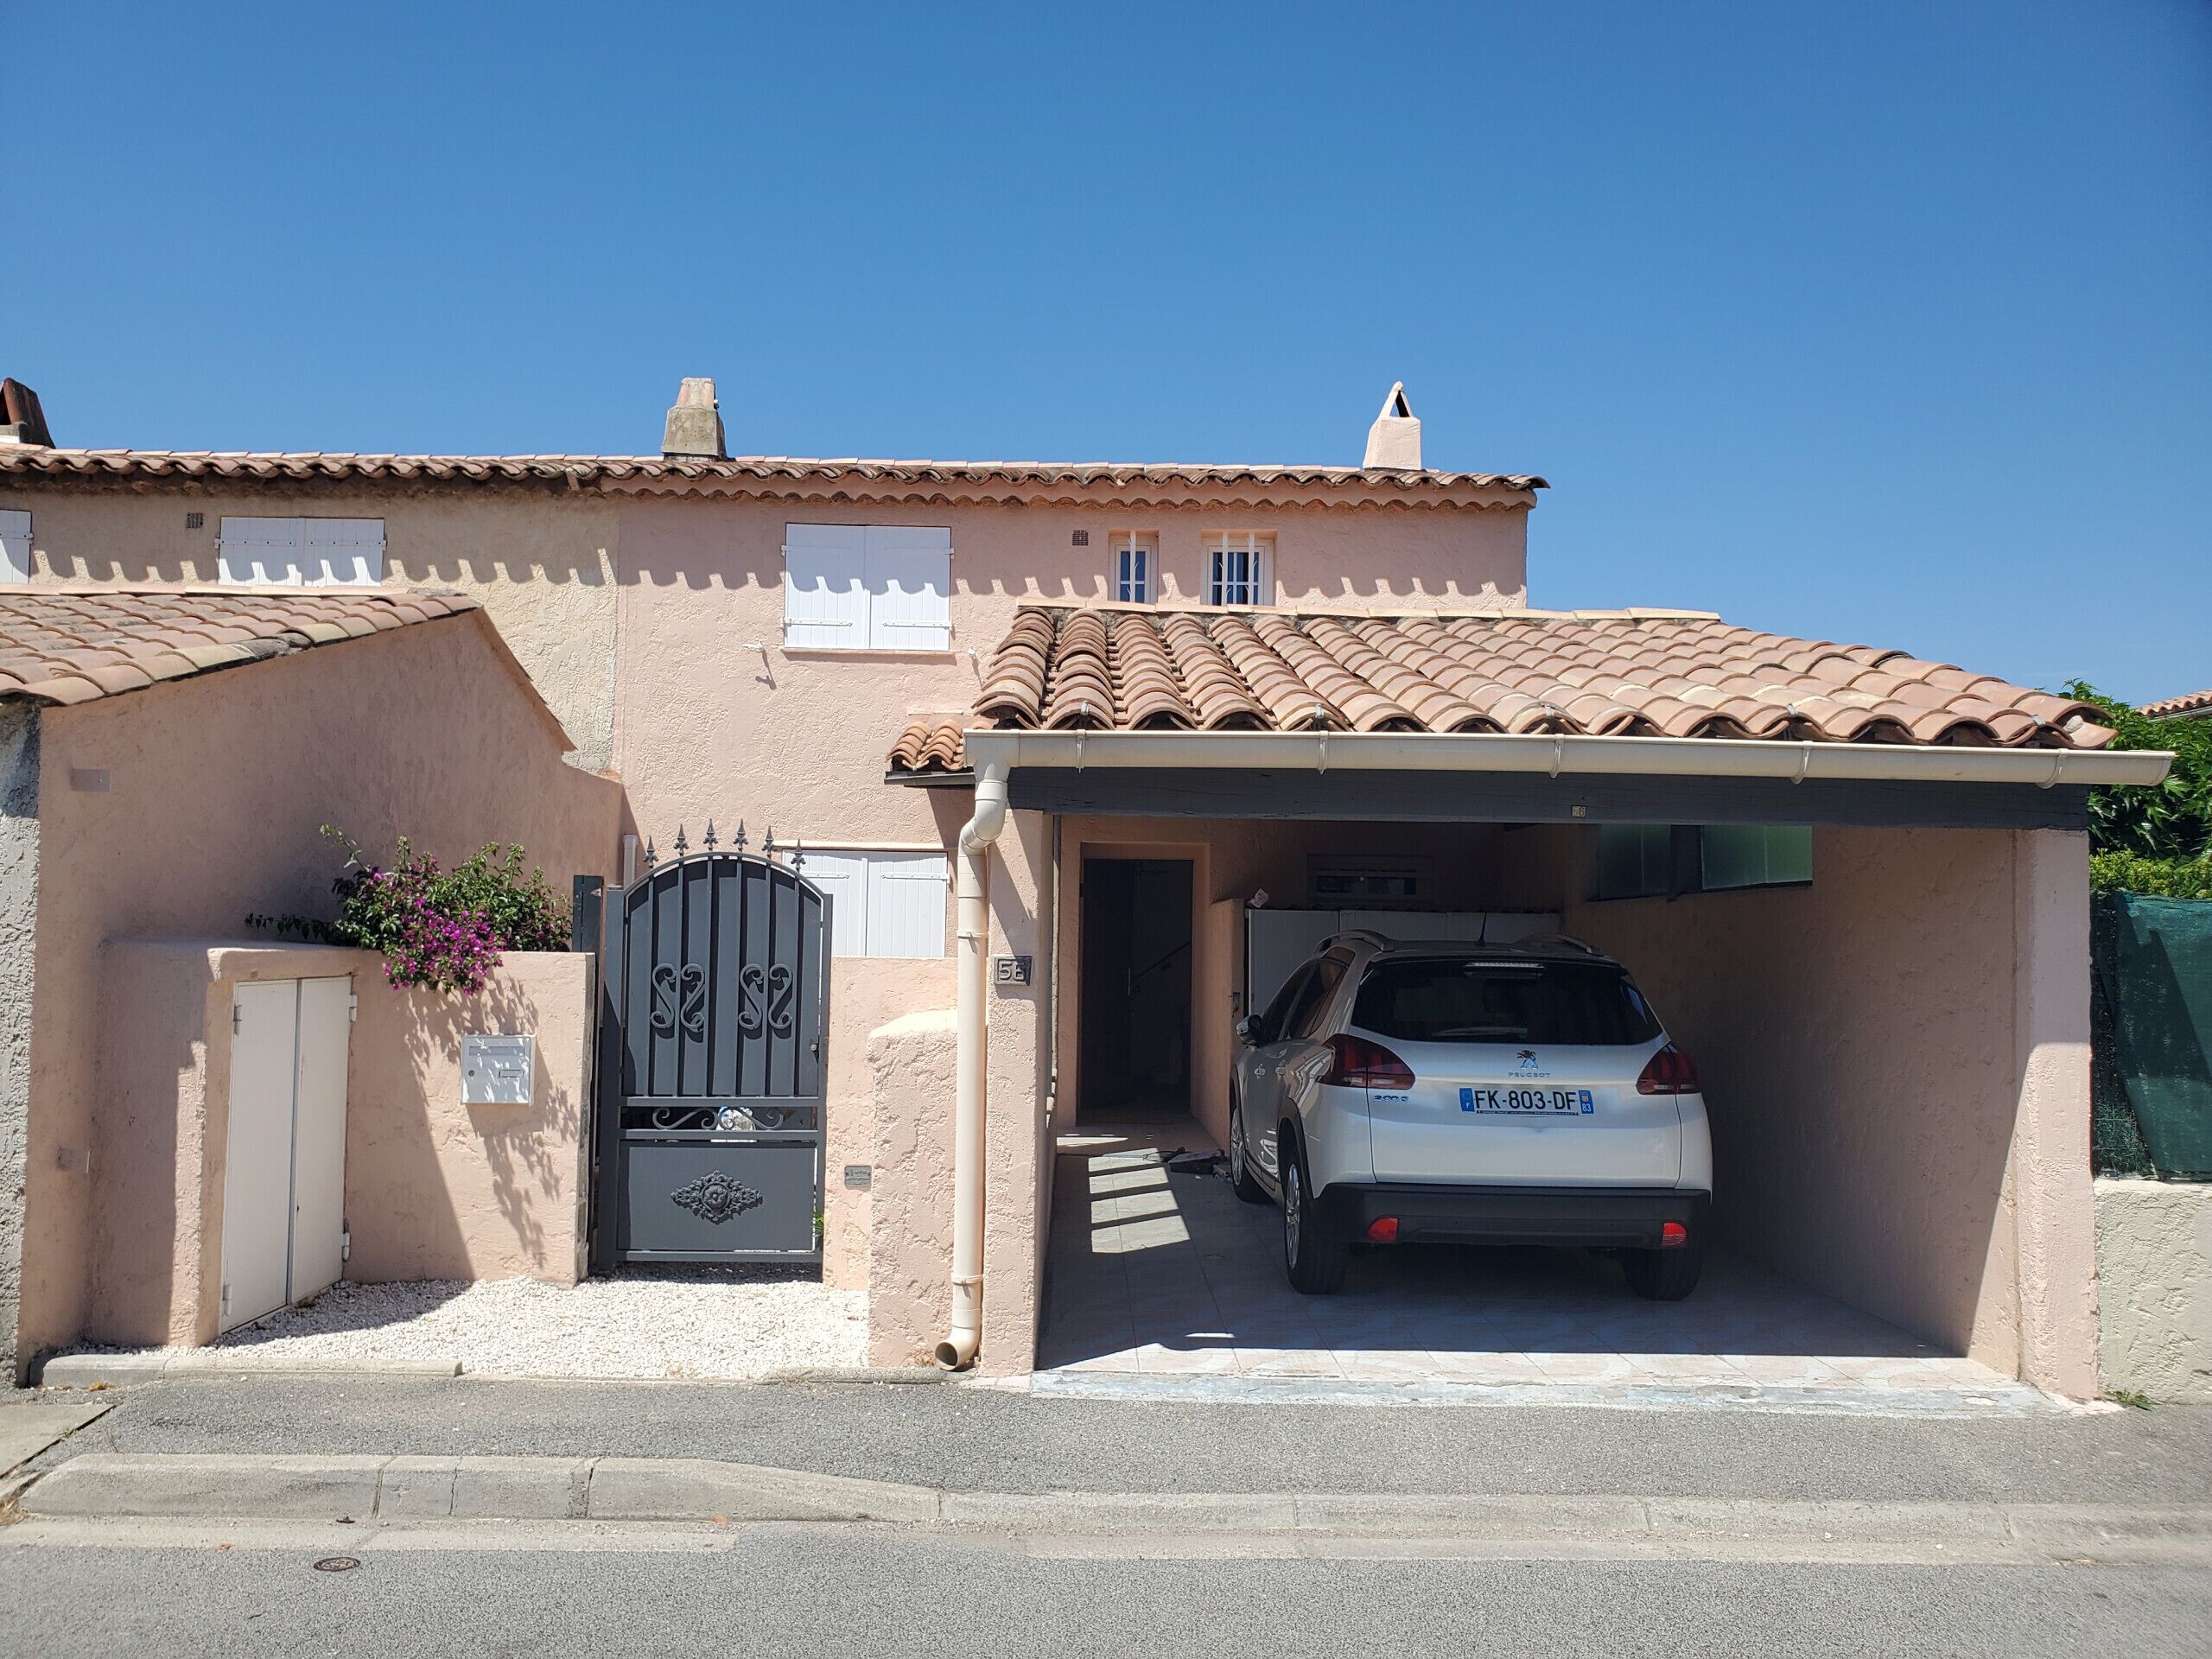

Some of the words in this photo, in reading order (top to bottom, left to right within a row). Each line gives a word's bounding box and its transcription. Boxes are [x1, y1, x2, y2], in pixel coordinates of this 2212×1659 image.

[998, 960, 1026, 981] 56
[1474, 1090, 1577, 1110] FK-803-DF
[1582, 1103, 1592, 1112] 83
